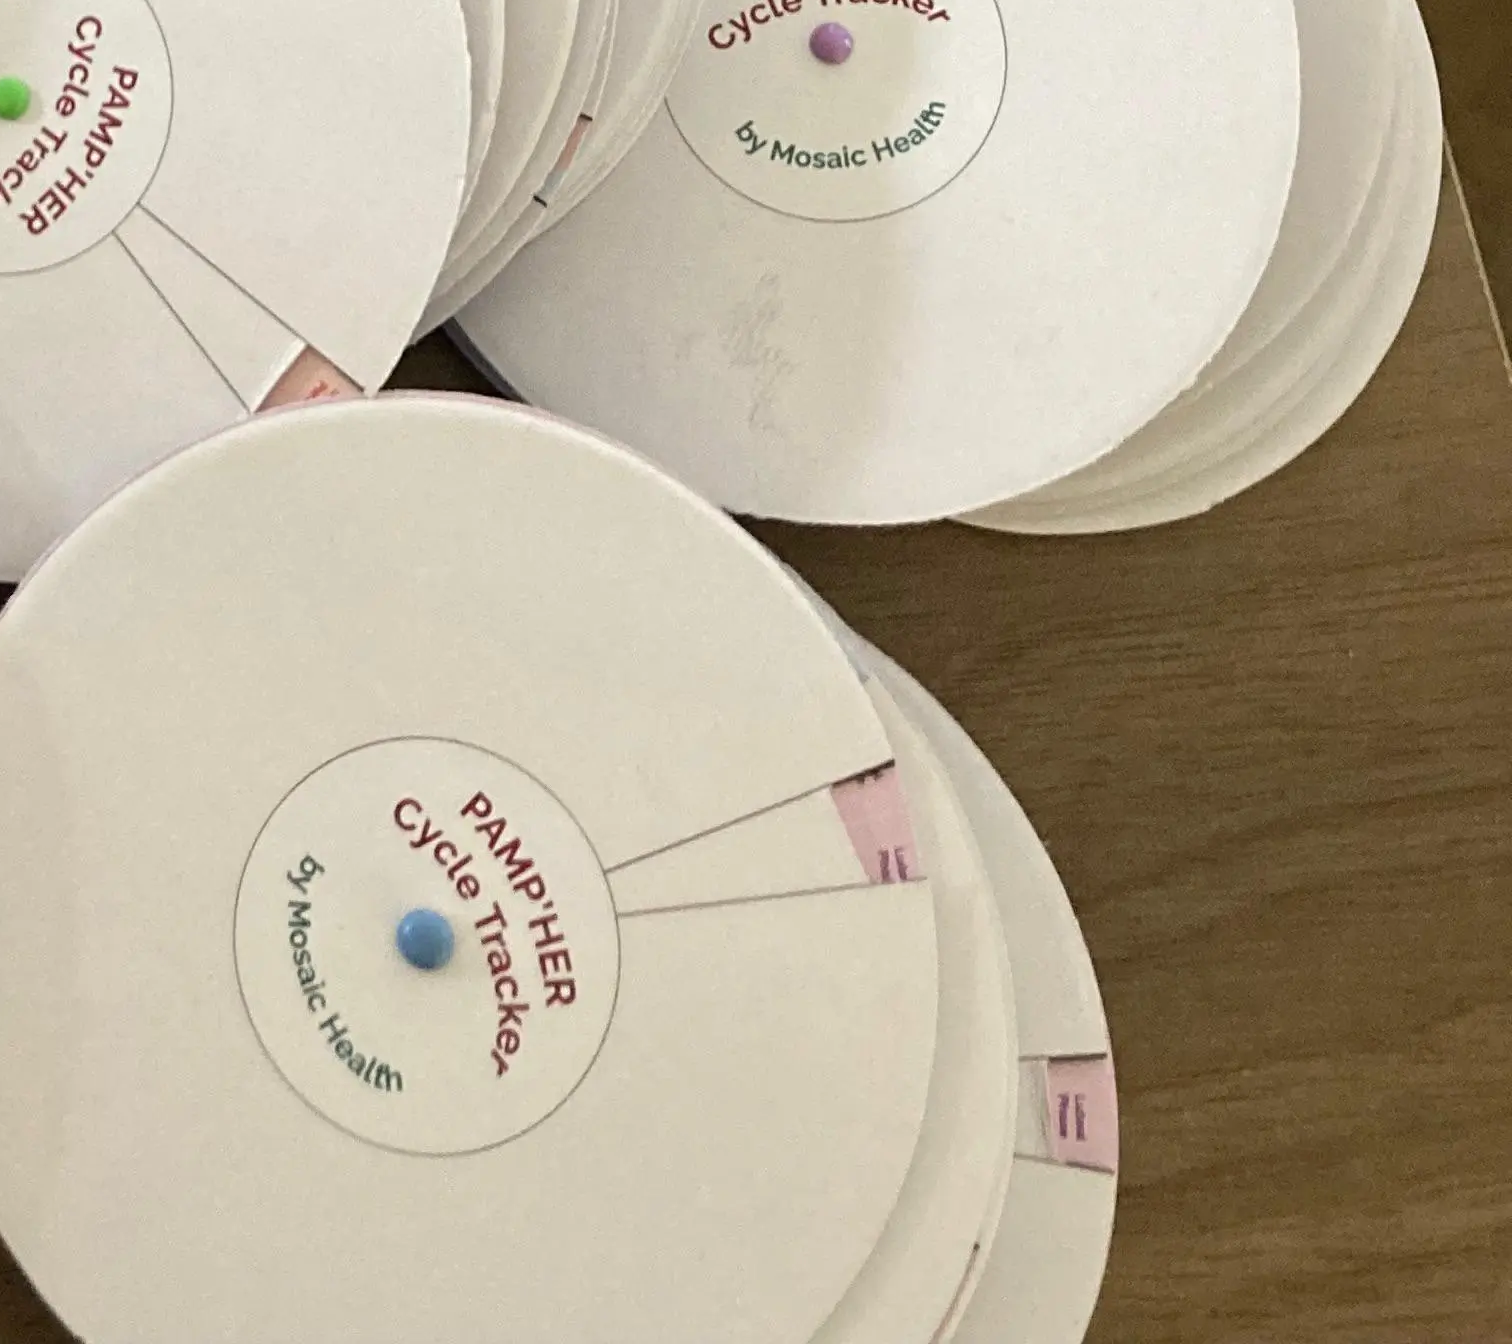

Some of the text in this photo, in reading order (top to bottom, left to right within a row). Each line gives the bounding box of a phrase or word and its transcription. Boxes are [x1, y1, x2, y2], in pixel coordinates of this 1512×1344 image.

[19, 64, 138, 236] PAMP'HER
[55, 15, 102, 117] Cycle
[734, 100, 946, 168] by Mosaic Health
[288, 854, 403, 1092] by Mosaic Health
[393, 797, 530, 1077] Cycle Tracker
[461, 791, 576, 1008] PAMP'HER
